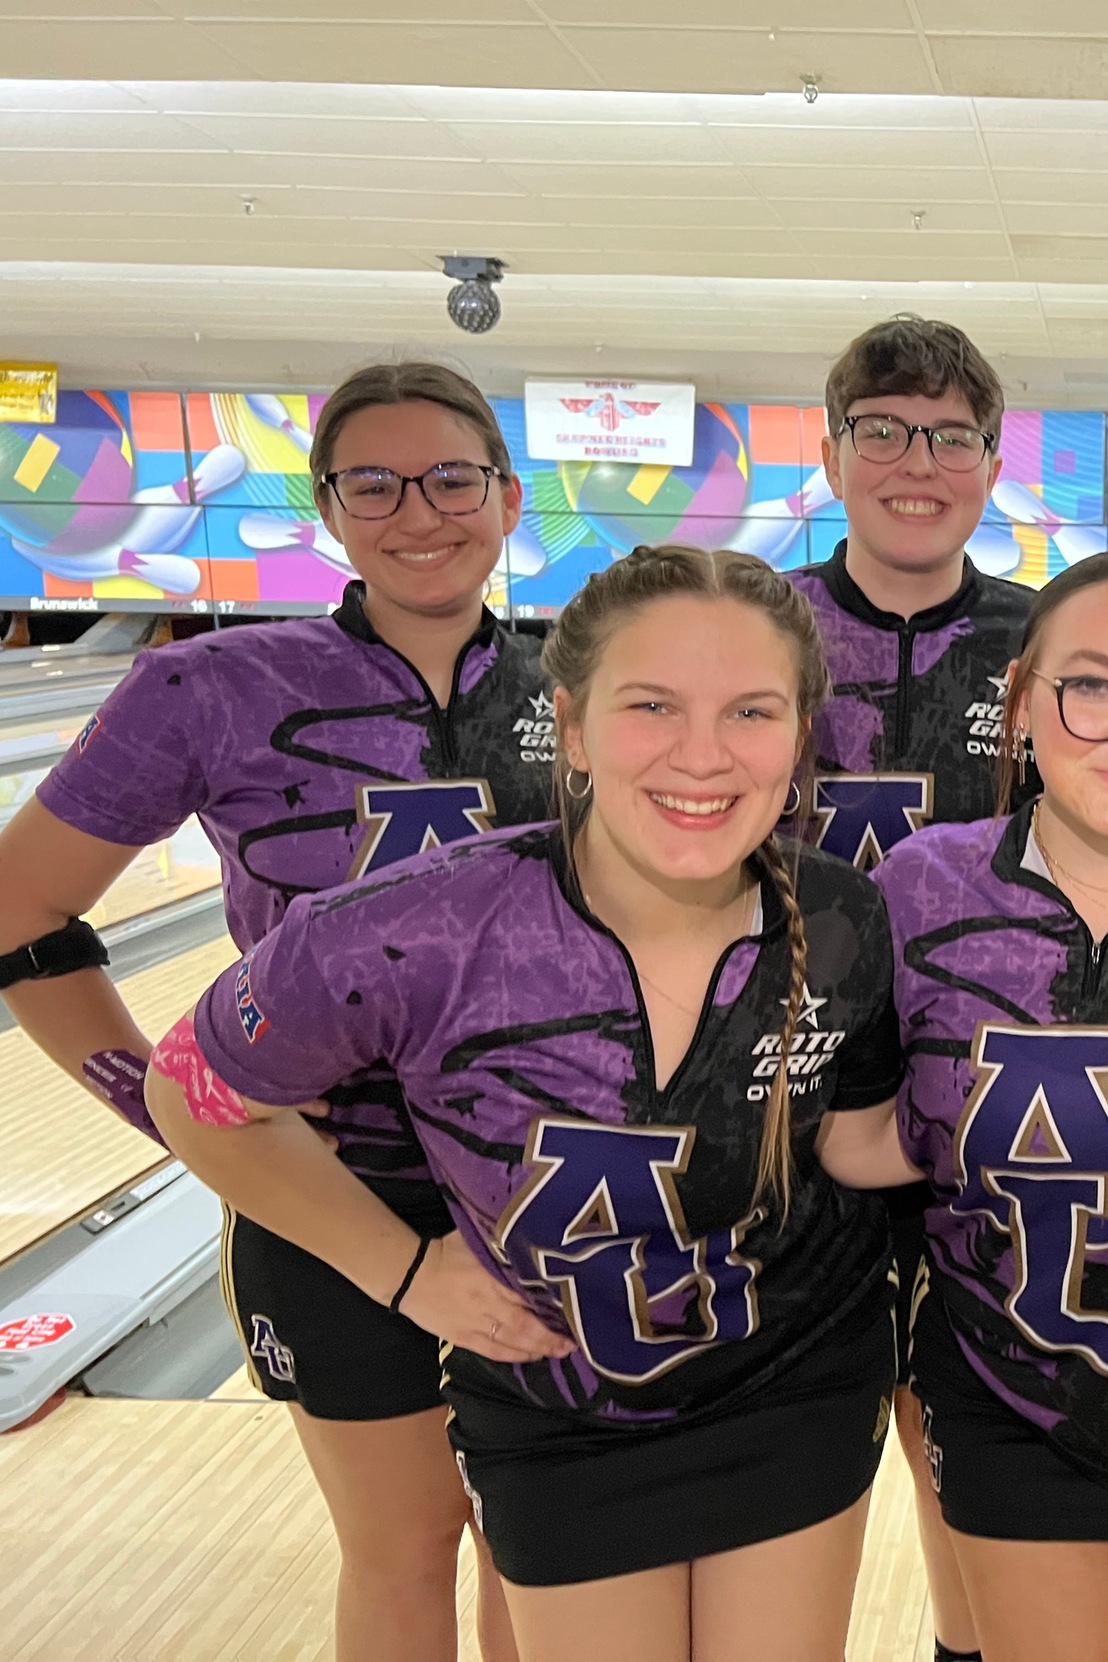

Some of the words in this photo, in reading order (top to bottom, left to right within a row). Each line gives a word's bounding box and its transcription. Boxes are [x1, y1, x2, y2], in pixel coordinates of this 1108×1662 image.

[30, 597, 98, 611] Brunswick
[219, 601, 236, 614] 17
[517, 604, 535, 618] 19
[965, 702, 1005, 721] RO
[512, 718, 555, 735] RO
[519, 733, 557, 749] GR
[520, 750, 556, 762] OW
[752, 1052, 834, 1077] GRIP
[496, 1116, 768, 1387] AU
